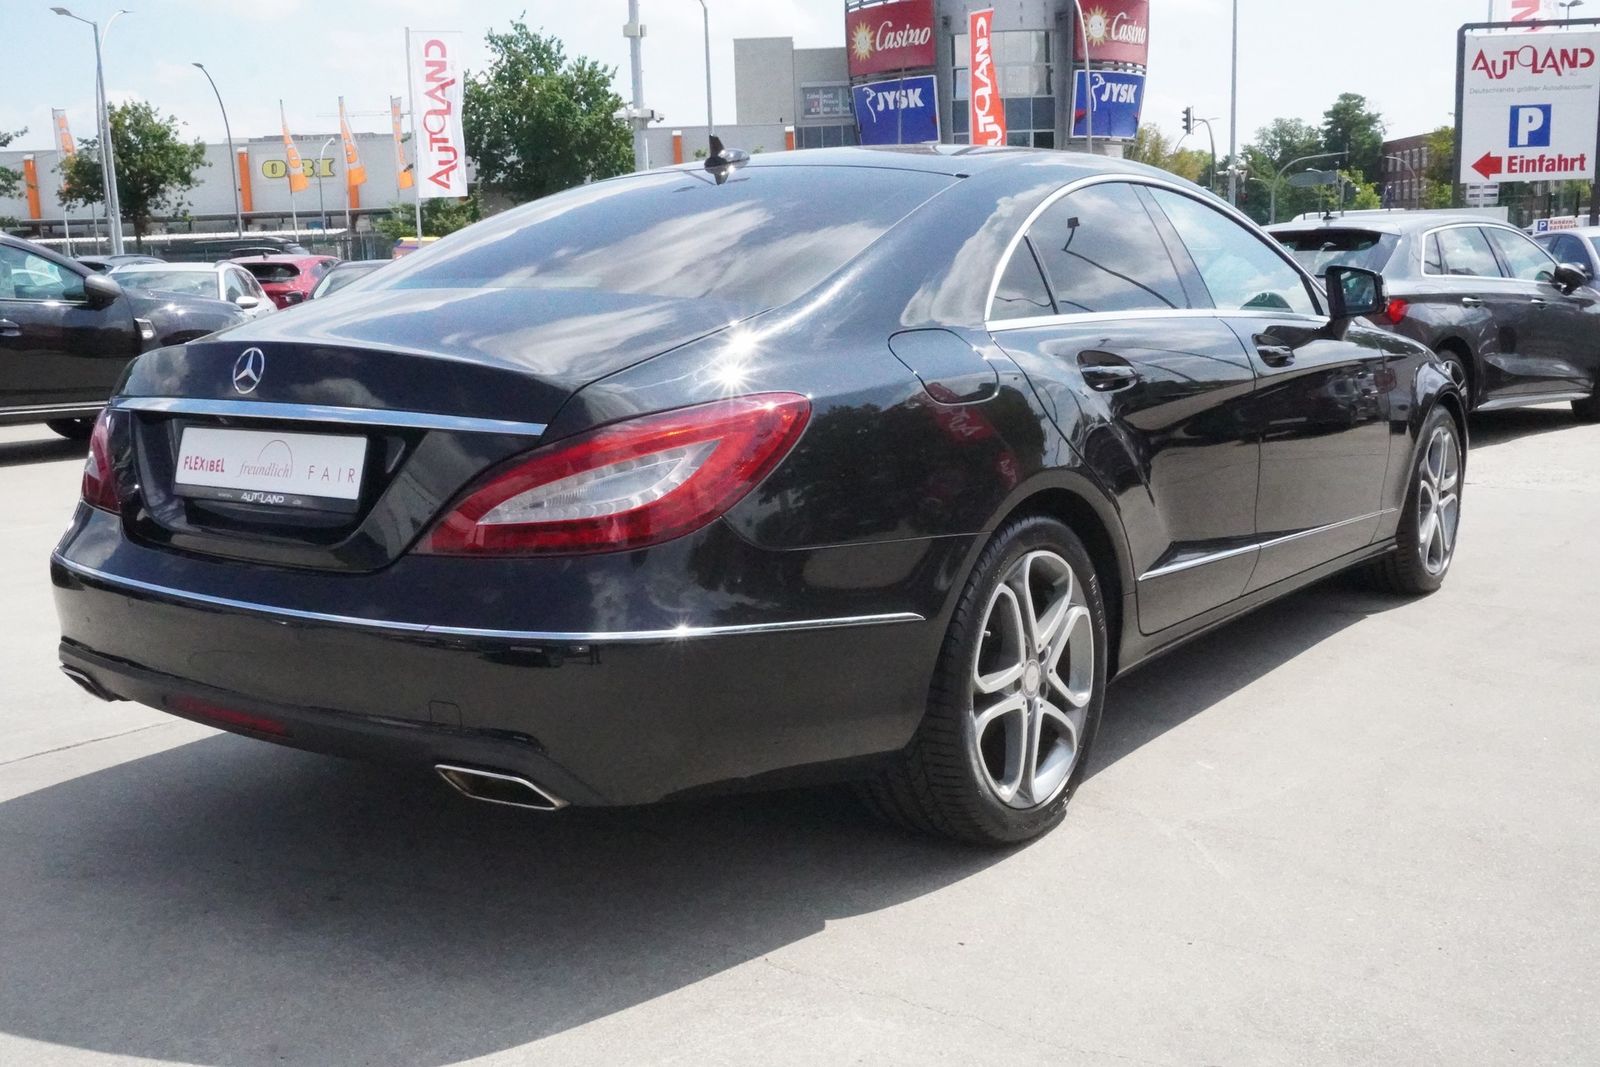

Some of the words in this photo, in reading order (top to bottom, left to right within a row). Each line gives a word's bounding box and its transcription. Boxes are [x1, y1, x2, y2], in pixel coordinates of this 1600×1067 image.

[875, 20, 931, 51] Casino
[1111, 12, 1147, 45] Casino
[1471, 45, 1595, 80] AUTOLAND
[974, 16, 1003, 146] UTOLAND
[1100, 82, 1138, 104] JYSK
[876, 88, 925, 112] JYSK
[423, 39, 458, 190] AUTOLAND
[1517, 107, 1544, 146] P
[1507, 153, 1587, 174] Einfahrt
[183, 455, 225, 473] FLEXIBEL
[236, 461, 291, 479] freundlich
[241, 492, 285, 504] AUTOLAND
